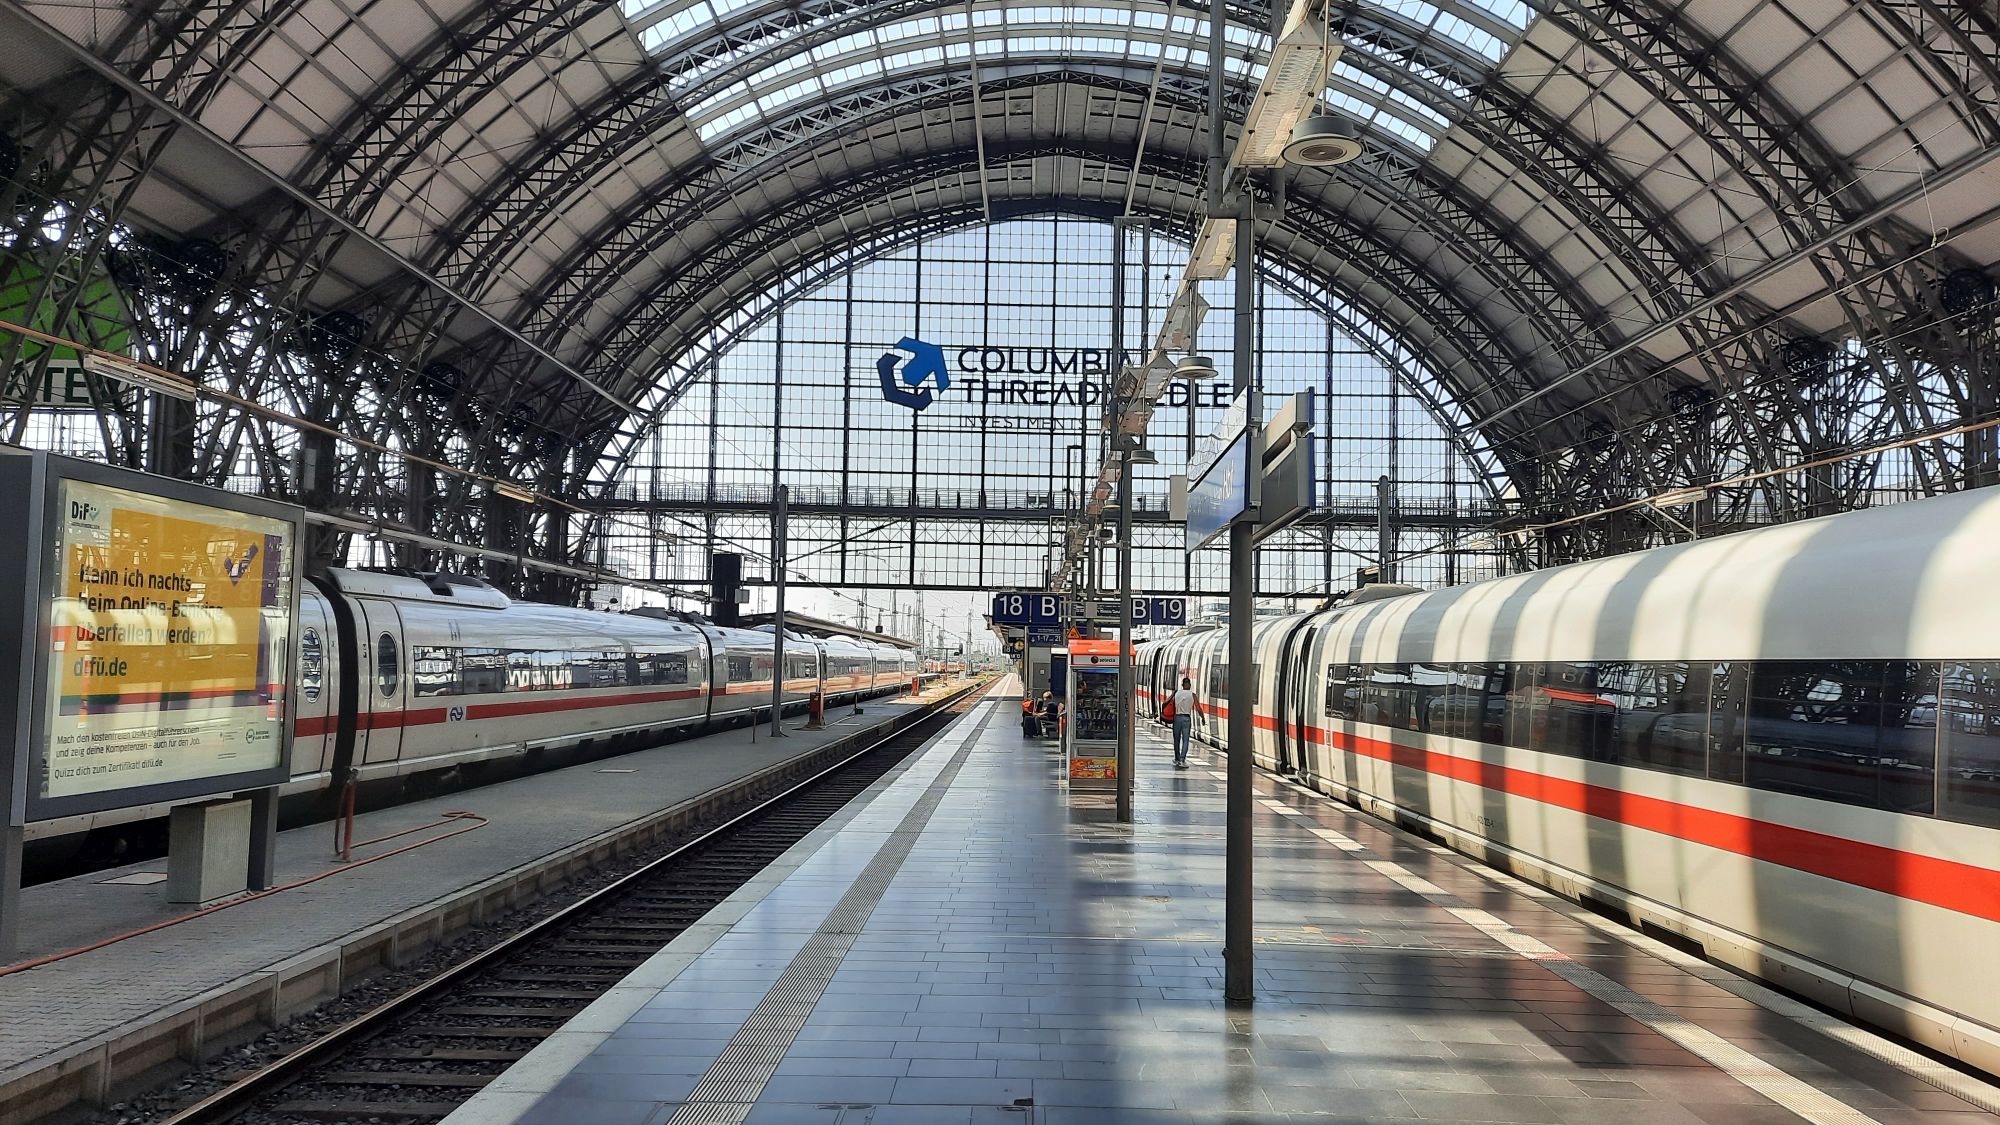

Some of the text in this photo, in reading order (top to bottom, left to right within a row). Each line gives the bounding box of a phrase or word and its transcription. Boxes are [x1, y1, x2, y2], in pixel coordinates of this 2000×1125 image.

[957, 347, 1134, 375] COLUMBIA
[960, 378, 1231, 408] THREADDLE
[960, 415, 1088, 431] INVESTMENTS
[79, 563, 192, 592] Kann ich nachts
[78, 591, 223, 622] beim Online-Banking
[999, 595, 1023, 616] 18
[1041, 596, 1056, 617] B
[1132, 598, 1147, 619] B
[1158, 598, 1183, 620] 19
[76, 621, 212, 645] überfallen werden?
[73, 656, 128, 677] difü.de
[55, 748, 69, 758] und
[70, 746, 85, 757] zeig
[86, 745, 104, 755] deine
[105, 742, 148, 753] Kompetenzen
[153, 740, 167, 749] auch
[168, 739, 177, 748] für
[178, 738, 189, 747] den
[57, 734, 75, 744] Mach
[76, 734, 90, 743] den
[91, 731, 130, 742] kostenfreien
[54, 768, 74, 779] Quizz
[75, 766, 91, 776] dich
[92, 765, 107, 774] zum
